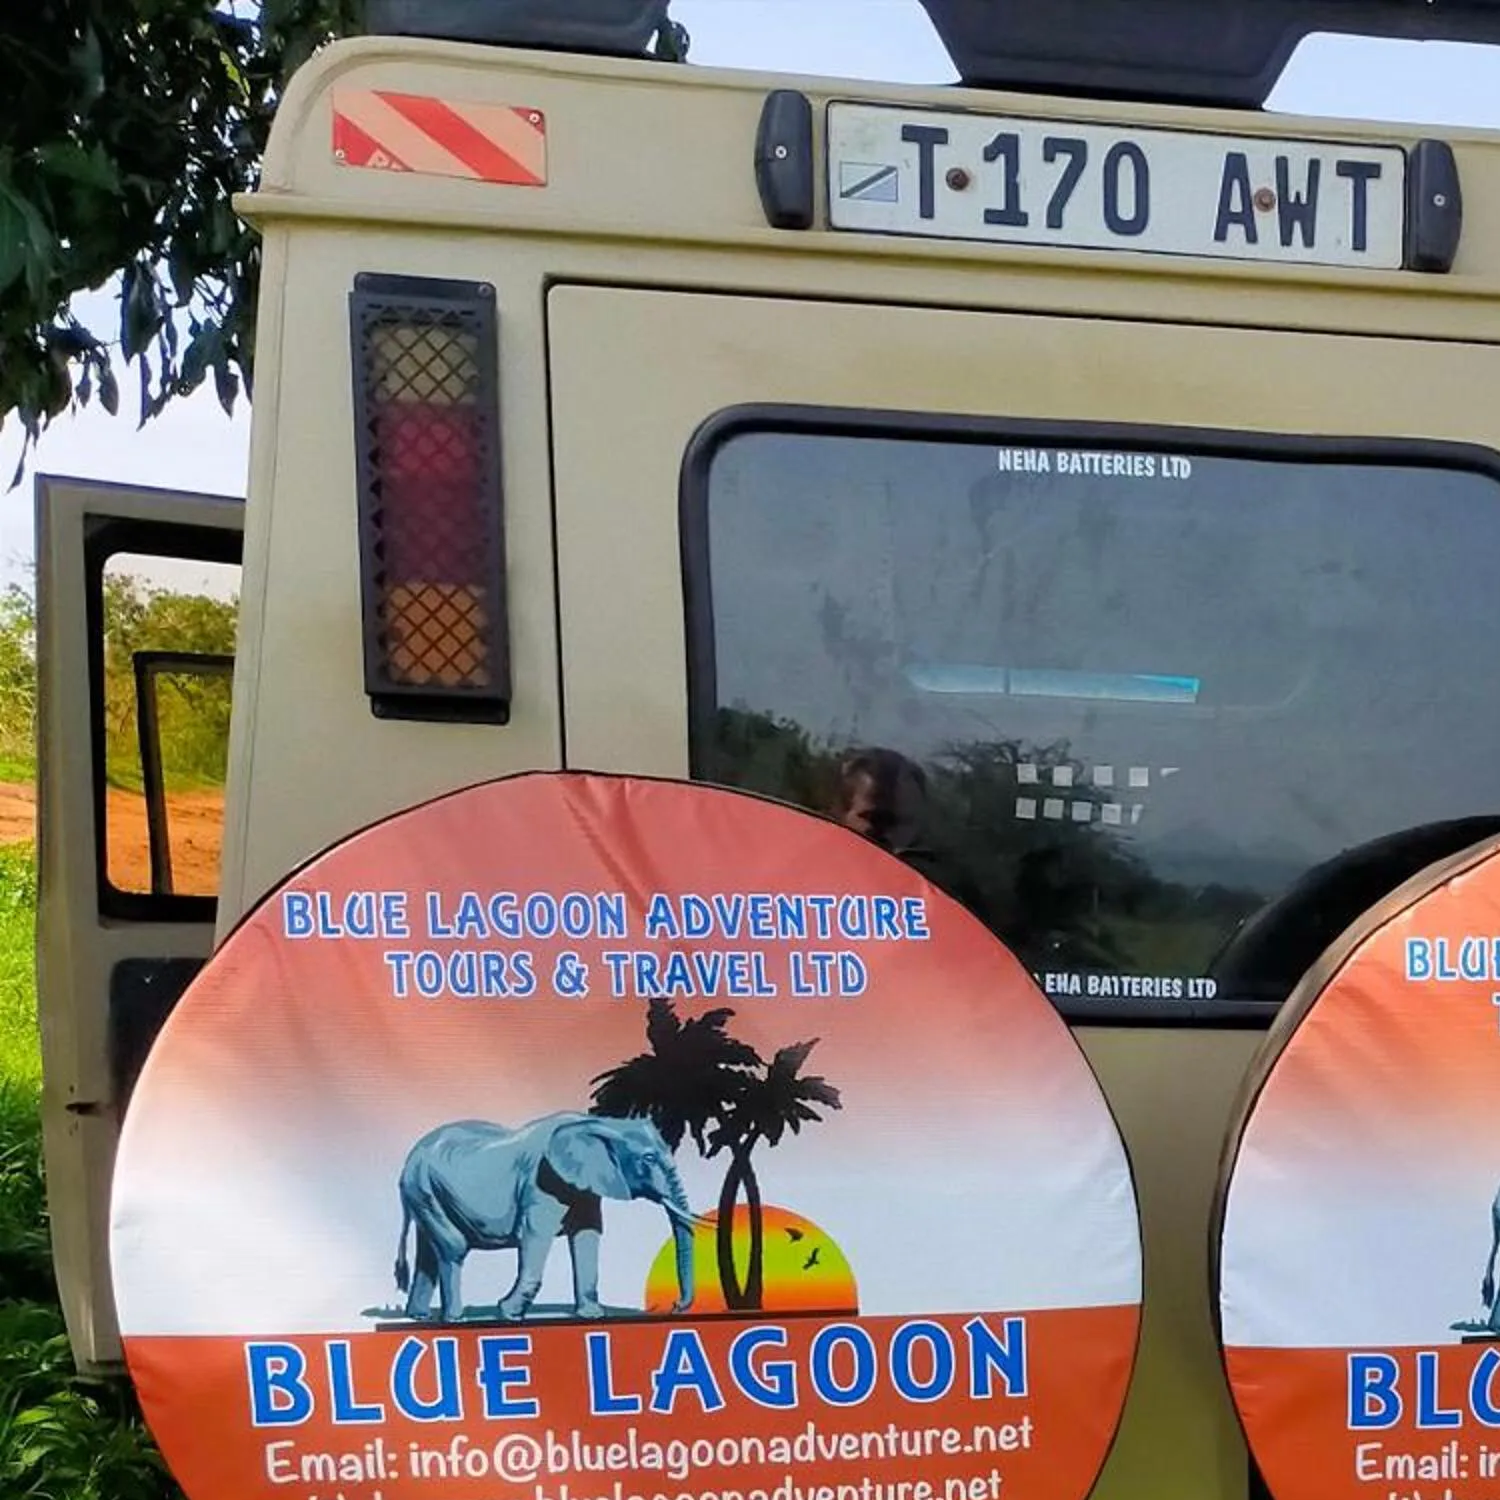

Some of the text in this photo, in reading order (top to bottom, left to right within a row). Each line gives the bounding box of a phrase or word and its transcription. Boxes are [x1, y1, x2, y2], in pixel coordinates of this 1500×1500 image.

[1213, 151, 1382, 252] AWT
[999, 449, 1192, 479] NEHA BATTERIES LTD
[284, 891, 930, 939] BLUE LAGOON ADVENTURE
[385, 950, 867, 999] TOURS & TRAVEL LTD
[1034, 973, 1217, 999] EHA BATTERIES LTD
[244, 1315, 1029, 1427] BLUE LAGOON
[265, 1416, 1034, 1484] Email: info@bluelagoonadventure.net
[1355, 1440, 1469, 1482] Email:
